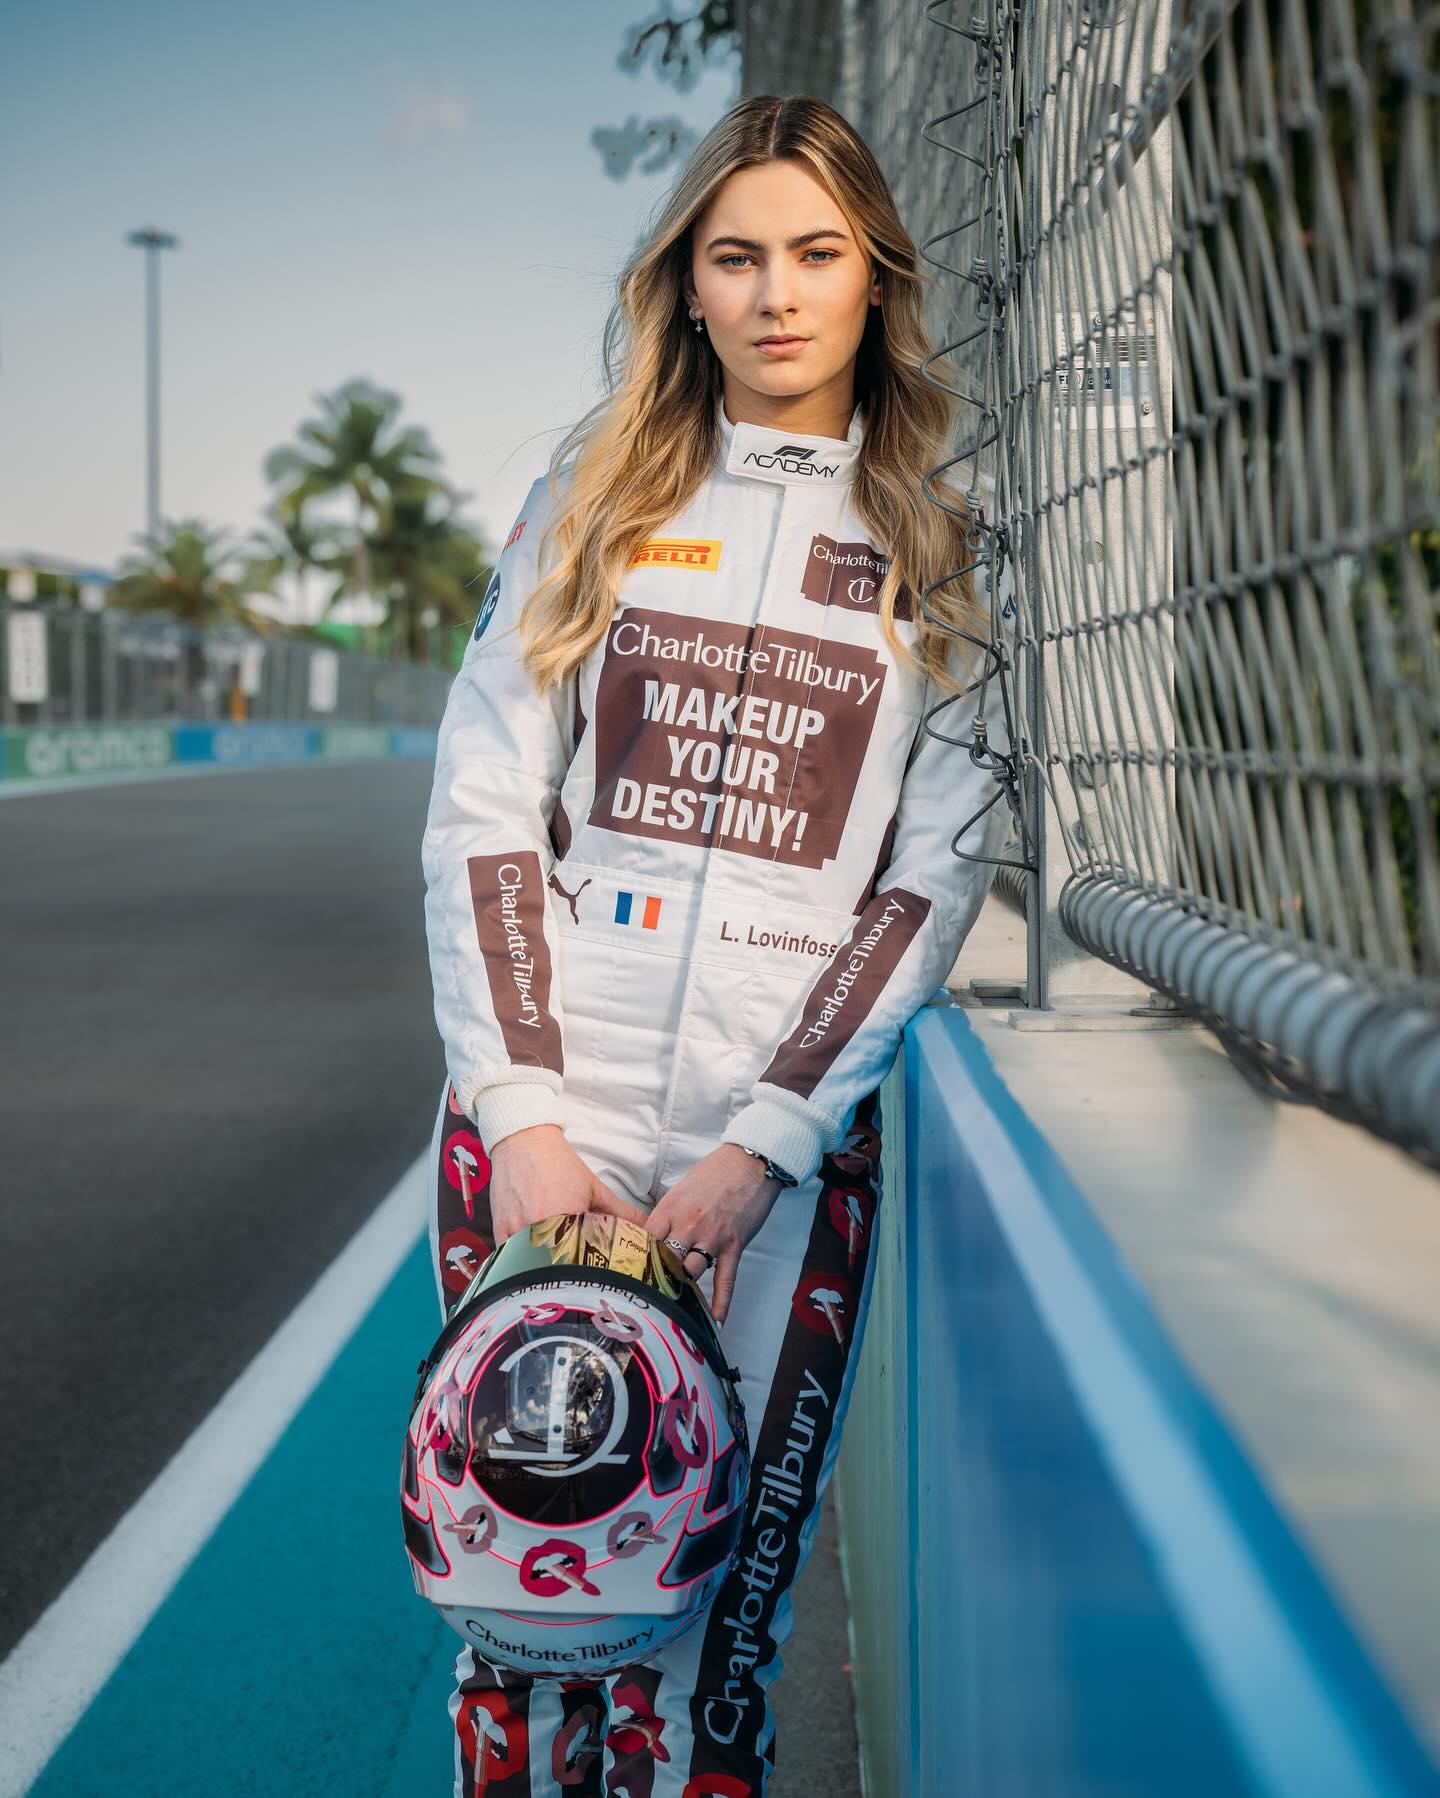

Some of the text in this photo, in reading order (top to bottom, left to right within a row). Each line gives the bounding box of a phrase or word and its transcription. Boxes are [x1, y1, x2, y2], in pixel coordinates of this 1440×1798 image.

[743, 452, 840, 478] ACADEMY
[642, 679, 825, 749] MAKEUP
[667, 735, 779, 794] YOUR
[611, 777, 808, 852] DESTINY!
[720, 921, 838, 958] L. Lovinfoss
